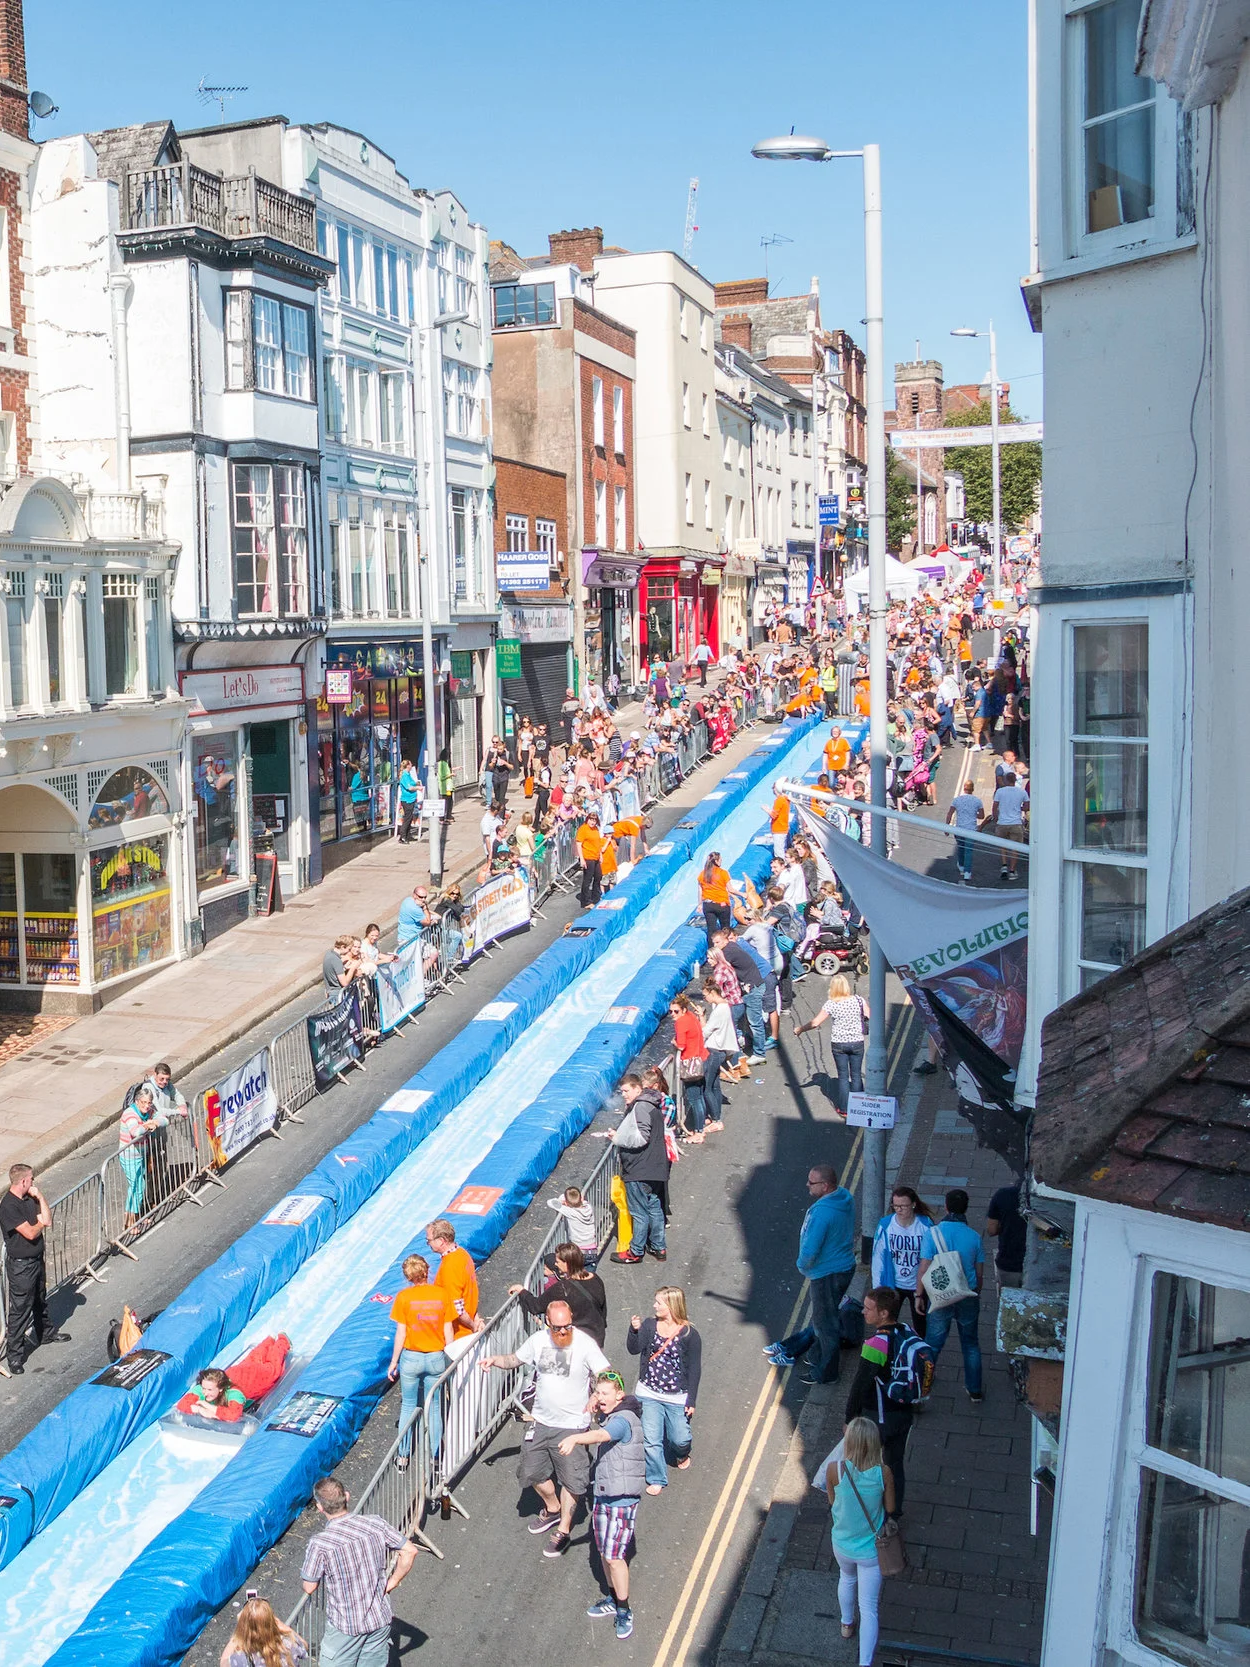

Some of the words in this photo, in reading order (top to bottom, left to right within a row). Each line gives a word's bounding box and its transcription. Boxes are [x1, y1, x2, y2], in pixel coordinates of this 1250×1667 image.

[498, 553, 527, 562] HAARER
[498, 644, 519, 654] TBM
[375, 690, 387, 704] 24
[850, 1109, 892, 1118] REGISTRATION
